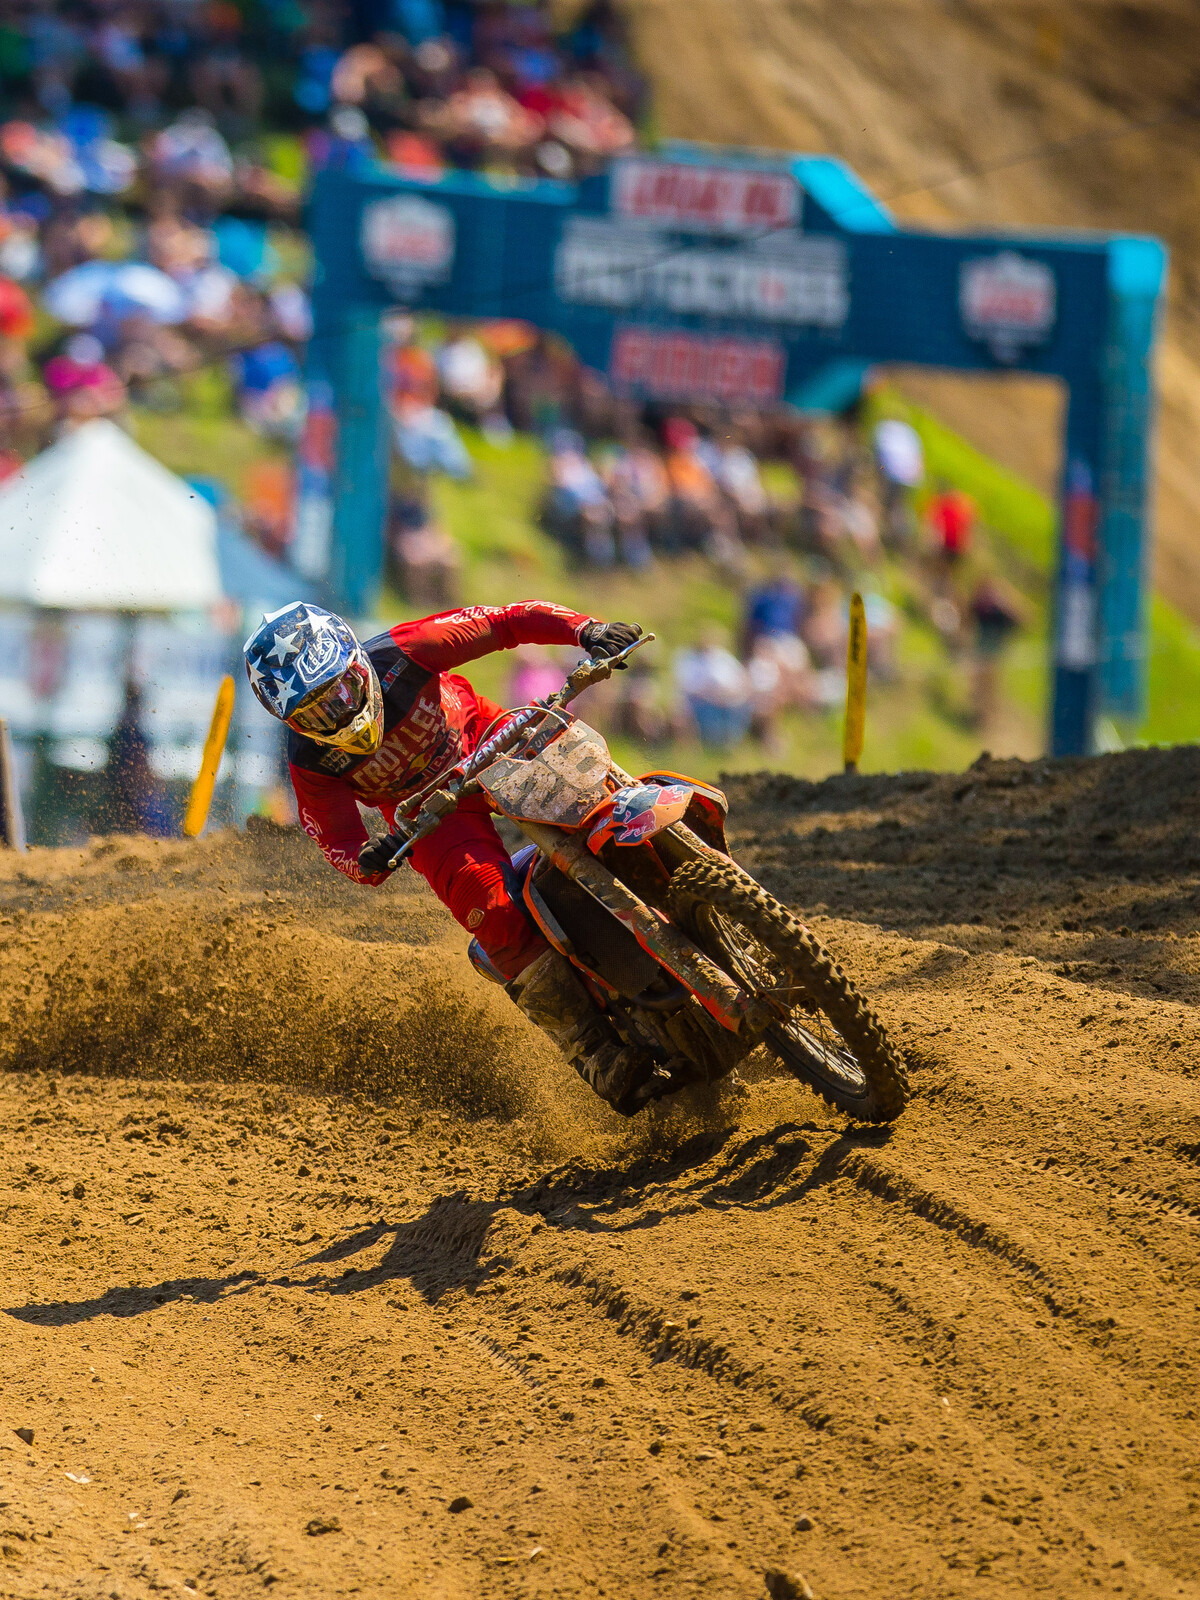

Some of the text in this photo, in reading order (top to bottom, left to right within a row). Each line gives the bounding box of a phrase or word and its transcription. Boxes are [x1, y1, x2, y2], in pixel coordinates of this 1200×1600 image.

[352, 733, 409, 787] TROY
[400, 696, 437, 743] LEE
[500, 726, 611, 822] 26
